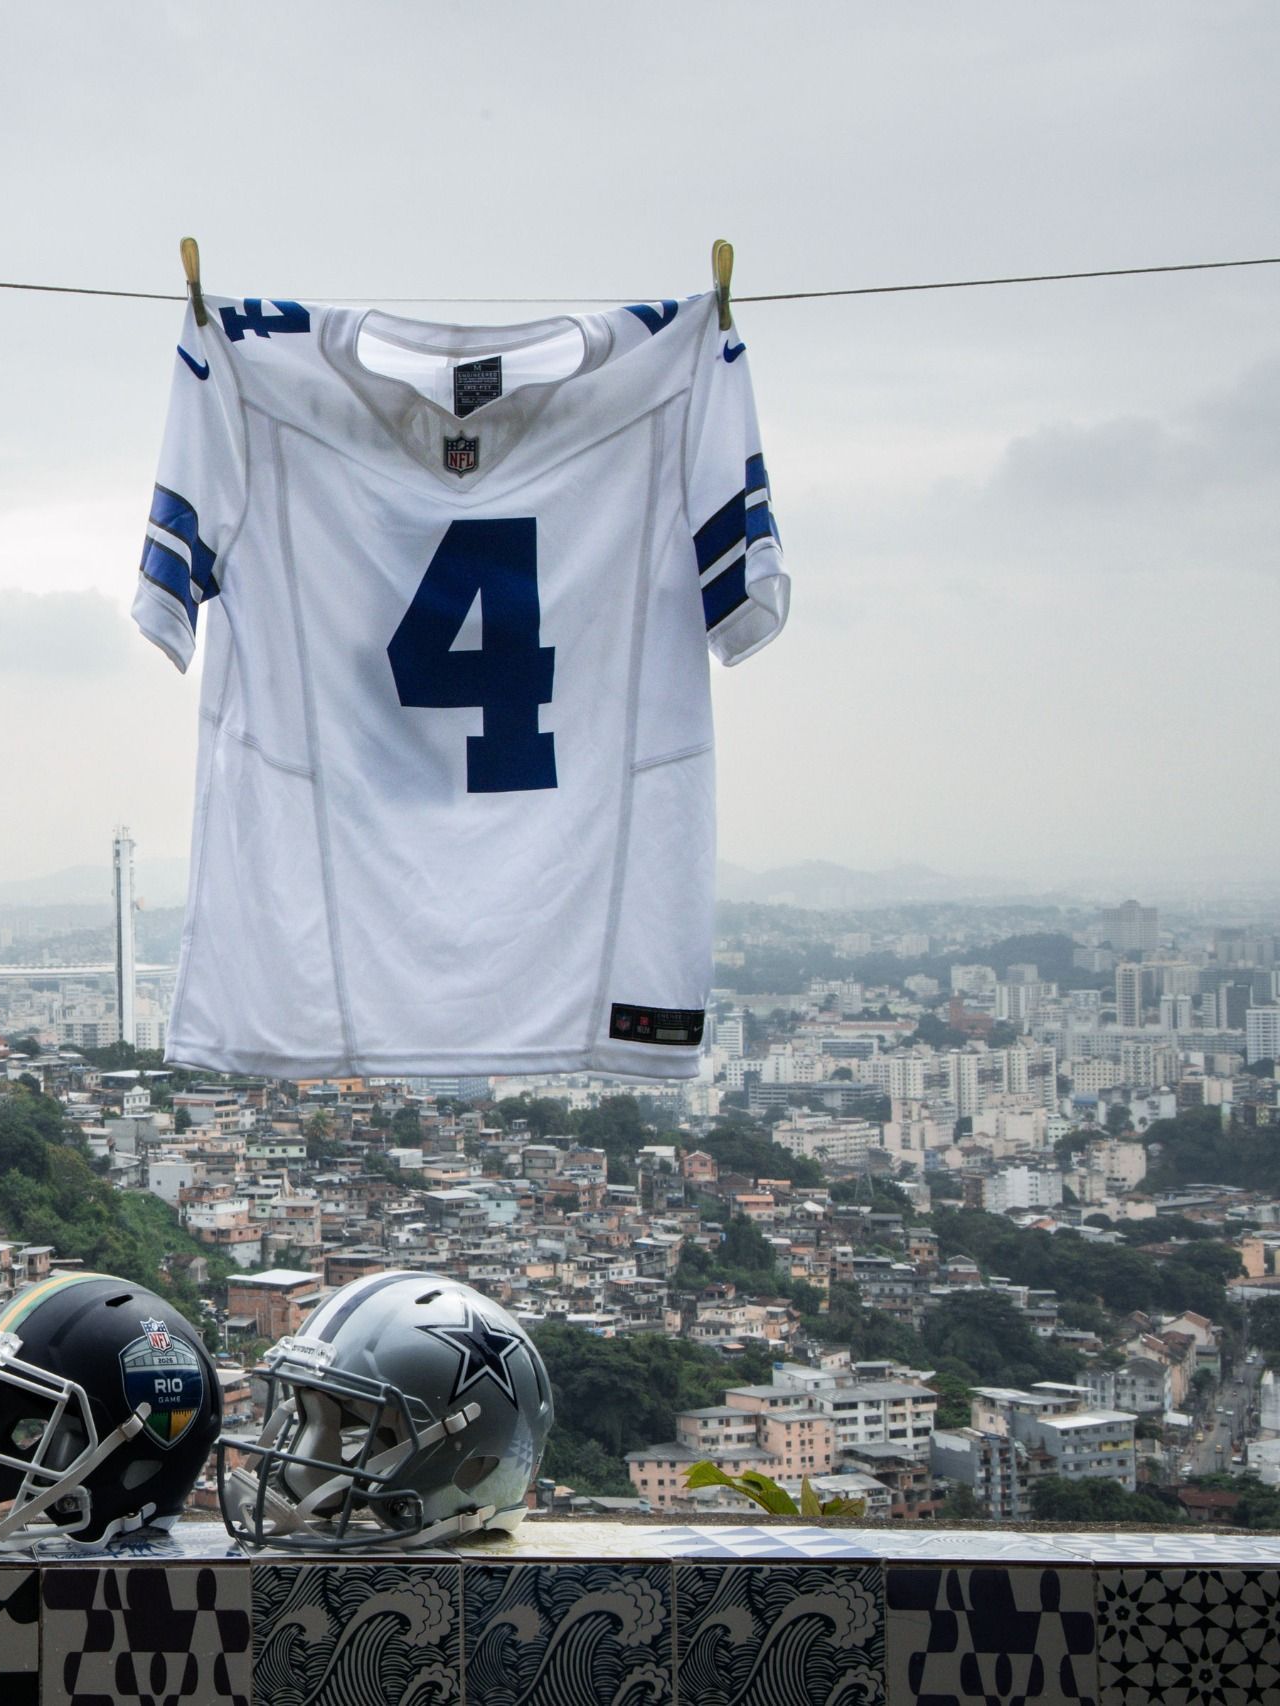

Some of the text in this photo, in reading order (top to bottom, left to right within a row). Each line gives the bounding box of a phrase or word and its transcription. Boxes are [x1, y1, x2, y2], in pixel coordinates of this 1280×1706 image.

[449, 452, 473, 468] NFL
[386, 517, 558, 793] 4
[150, 1333, 171, 1349] NFL
[153, 1377, 183, 1394] RIO
[157, 1395, 181, 1404] GAME
